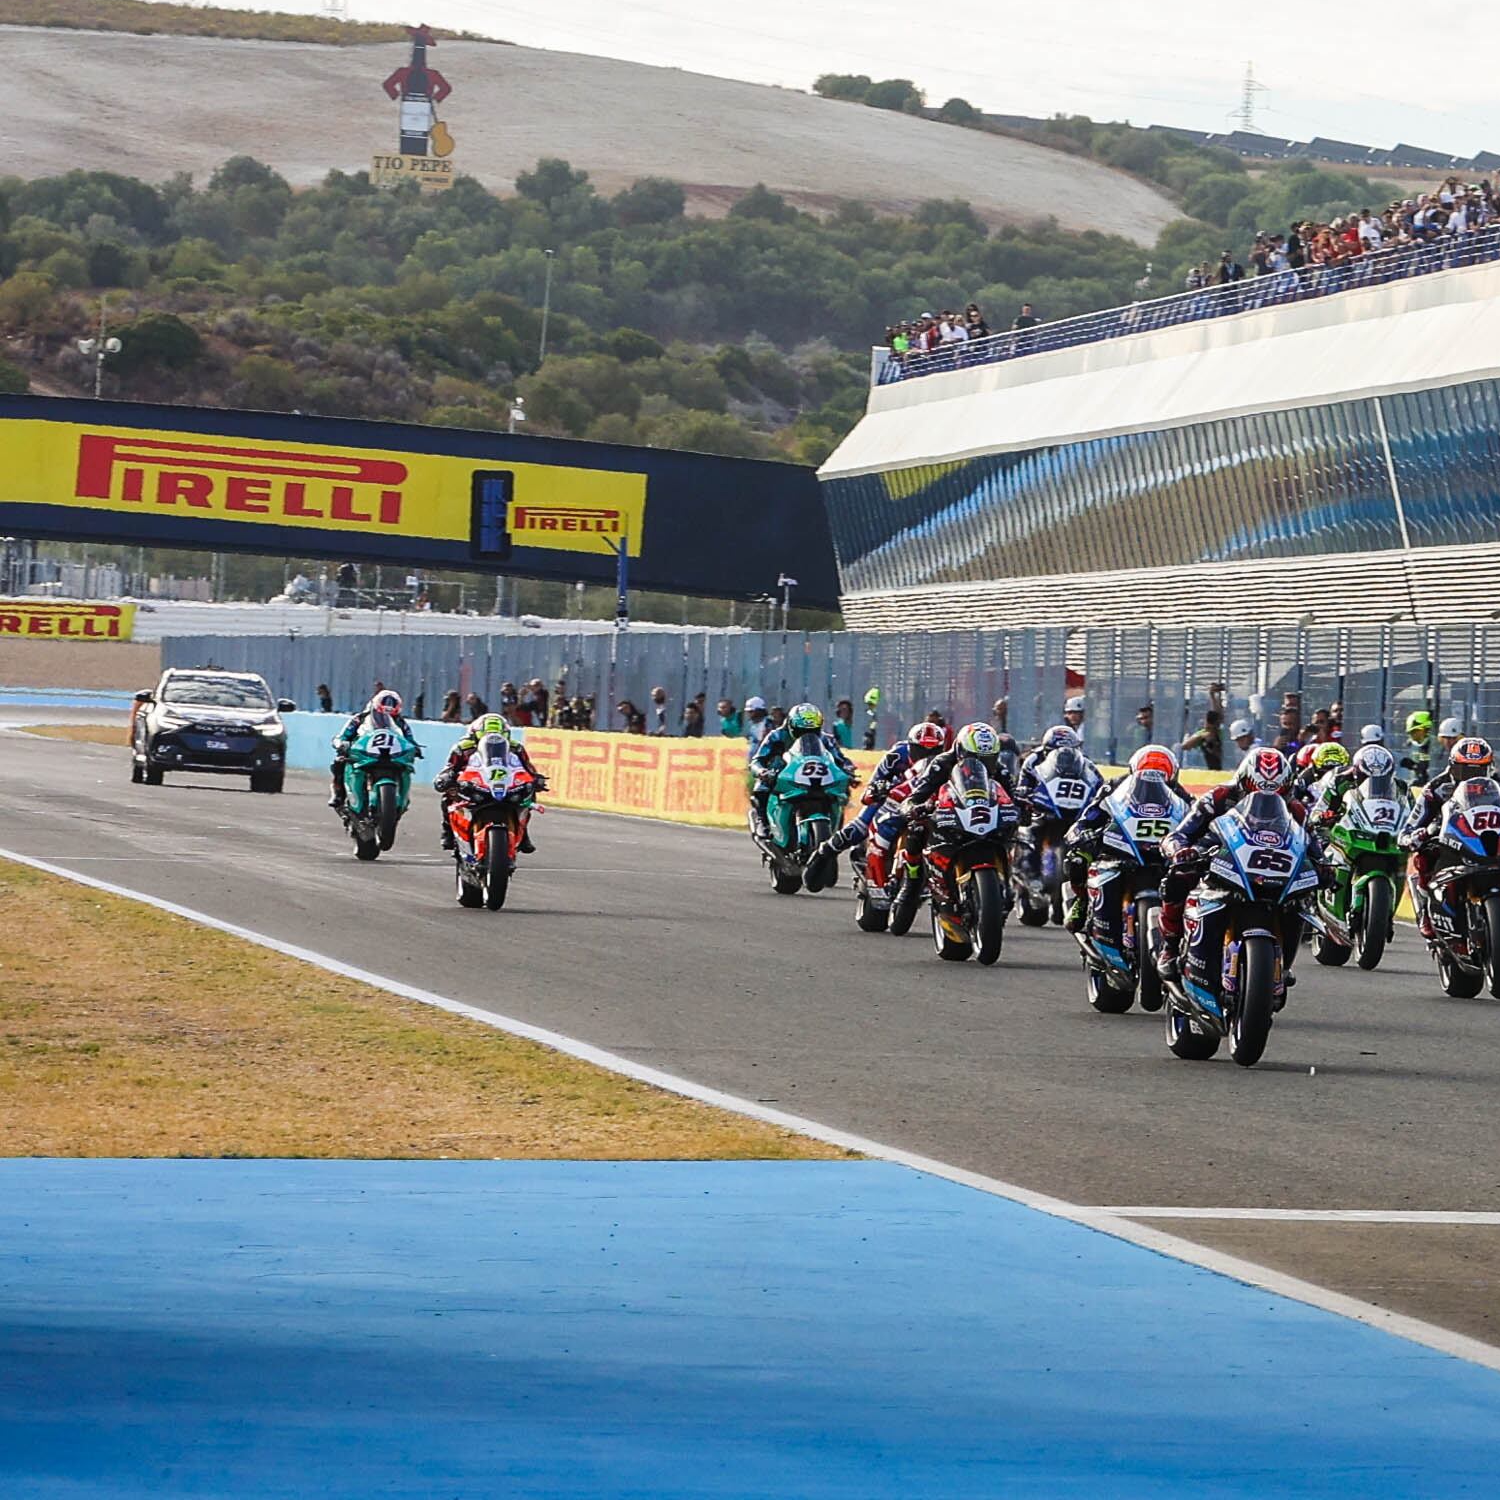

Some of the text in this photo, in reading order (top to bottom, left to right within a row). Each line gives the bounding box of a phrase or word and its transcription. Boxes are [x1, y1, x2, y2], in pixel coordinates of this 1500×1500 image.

[373, 156, 452, 173] TIO PEPE
[75, 434, 408, 525] PIRELLI
[513, 506, 621, 533] PIRELLI
[0, 602, 122, 638] RELLI
[372, 733, 394, 748] 21
[802, 761, 829, 776] 53
[1056, 781, 1087, 800] 99
[970, 806, 991, 827] 5
[1374, 807, 1396, 822] 31
[1136, 819, 1171, 838] 55
[1247, 849, 1294, 874] 65
